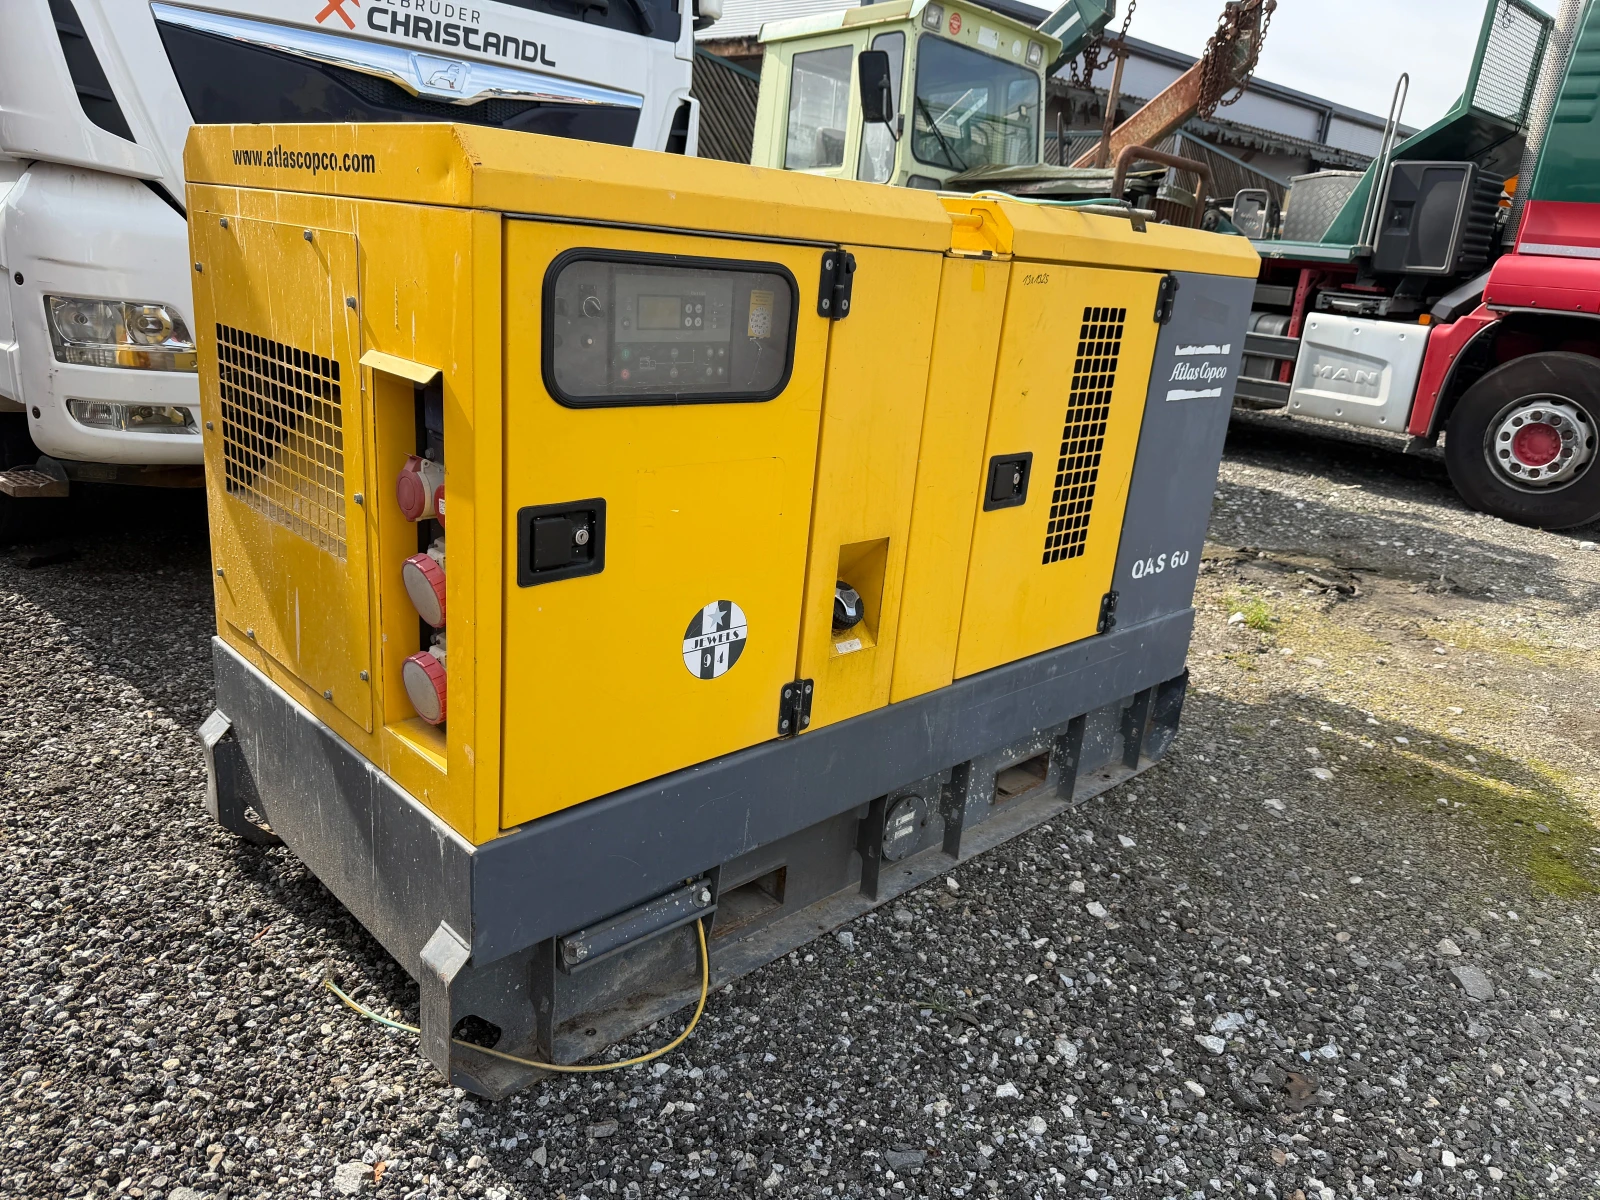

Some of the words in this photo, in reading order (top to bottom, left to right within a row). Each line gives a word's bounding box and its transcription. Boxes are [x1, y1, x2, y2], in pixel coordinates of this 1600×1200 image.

[374, 0, 481, 24] BRÜDER
[366, 6, 556, 67] CHRISTANDL
[232, 144, 376, 176] www.atlascopco.com
[1168, 361, 1200, 382] Atlas
[1200, 361, 1227, 384] Copco
[1312, 364, 1379, 387] MAN
[1131, 553, 1167, 580] QAS
[1170, 550, 1190, 569] 60
[691, 629, 739, 650] JEWELS
